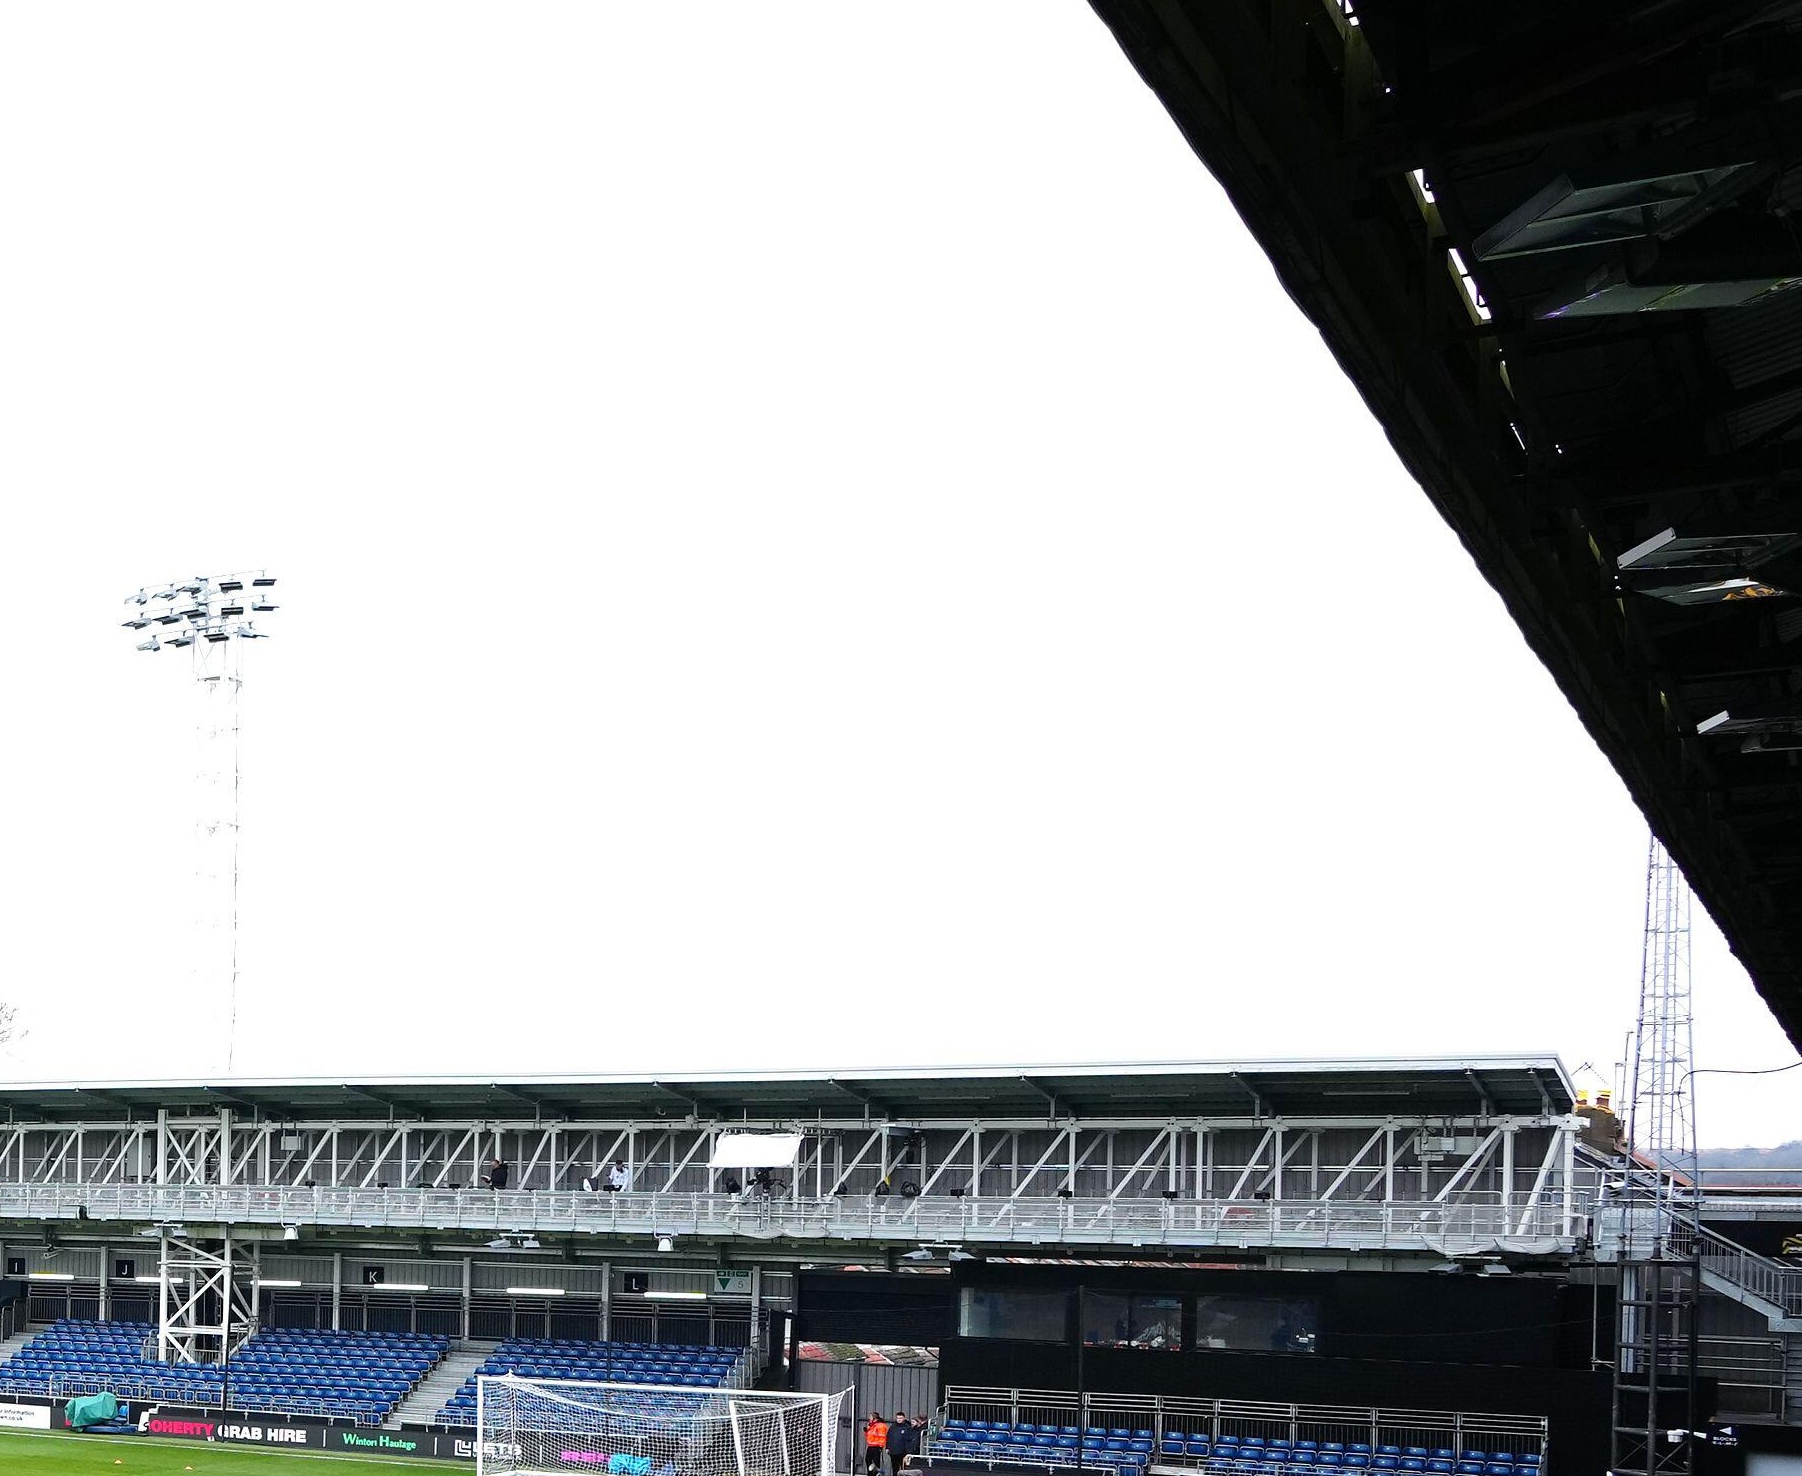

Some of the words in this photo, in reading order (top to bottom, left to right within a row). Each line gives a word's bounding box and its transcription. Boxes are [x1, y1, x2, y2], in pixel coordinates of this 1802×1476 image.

[122, 1265, 128, 1276] J
[369, 1272, 377, 1283] K
[633, 1278, 639, 1290] L
[150, 1420, 215, 1436] OHERTY
[218, 1424, 263, 1440] GRAB
[267, 1428, 307, 1443] HIRE
[379, 1436, 417, 1451] Haulage
